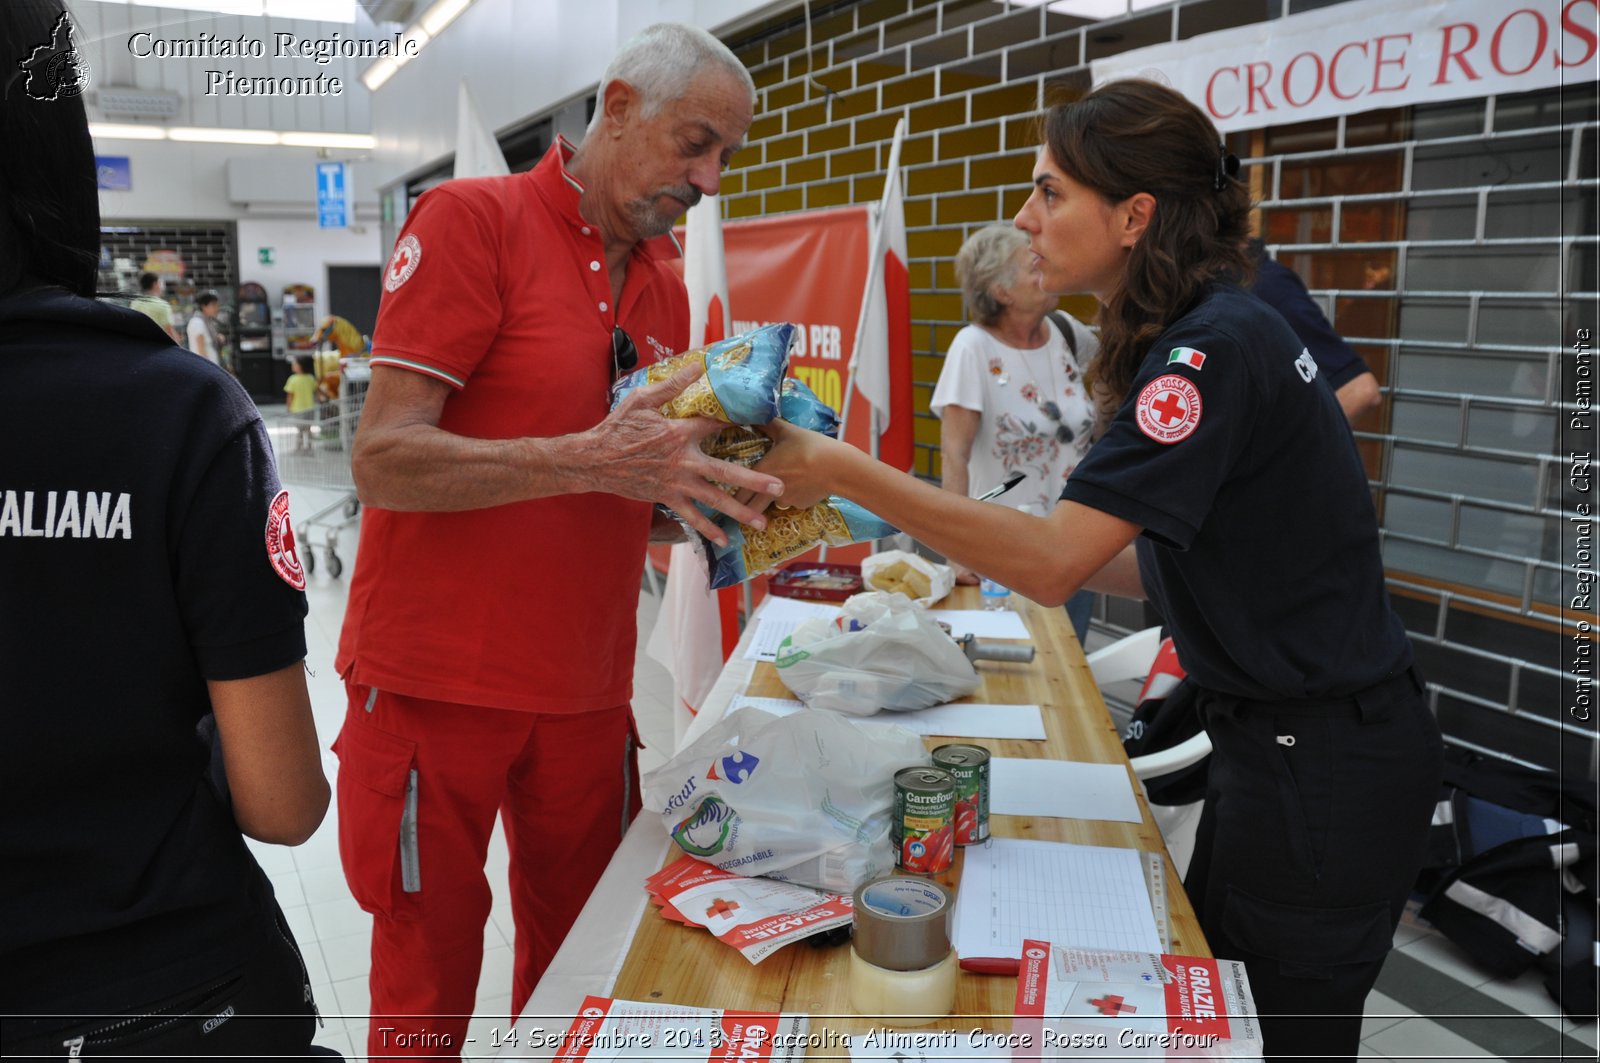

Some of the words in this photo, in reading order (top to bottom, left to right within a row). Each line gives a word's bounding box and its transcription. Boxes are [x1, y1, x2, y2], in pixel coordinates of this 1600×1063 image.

[1204, 33, 1414, 121] CROCE
[810, 325, 842, 360] PER
[1140, 383, 1160, 406] CROCE
[1160, 379, 1187, 393] ROSSA
[1185, 388, 1200, 424] ITALIANA
[0, 490, 132, 539] ALIANA
[906, 790, 954, 804] Carrefour
[745, 910, 835, 940] GRAZIE.
[1031, 974, 1039, 987] Rossa
[1032, 960, 1041, 973] Croce
[1029, 988, 1038, 1005] Italiana
[1189, 966, 1216, 1024] GRAZIE.
